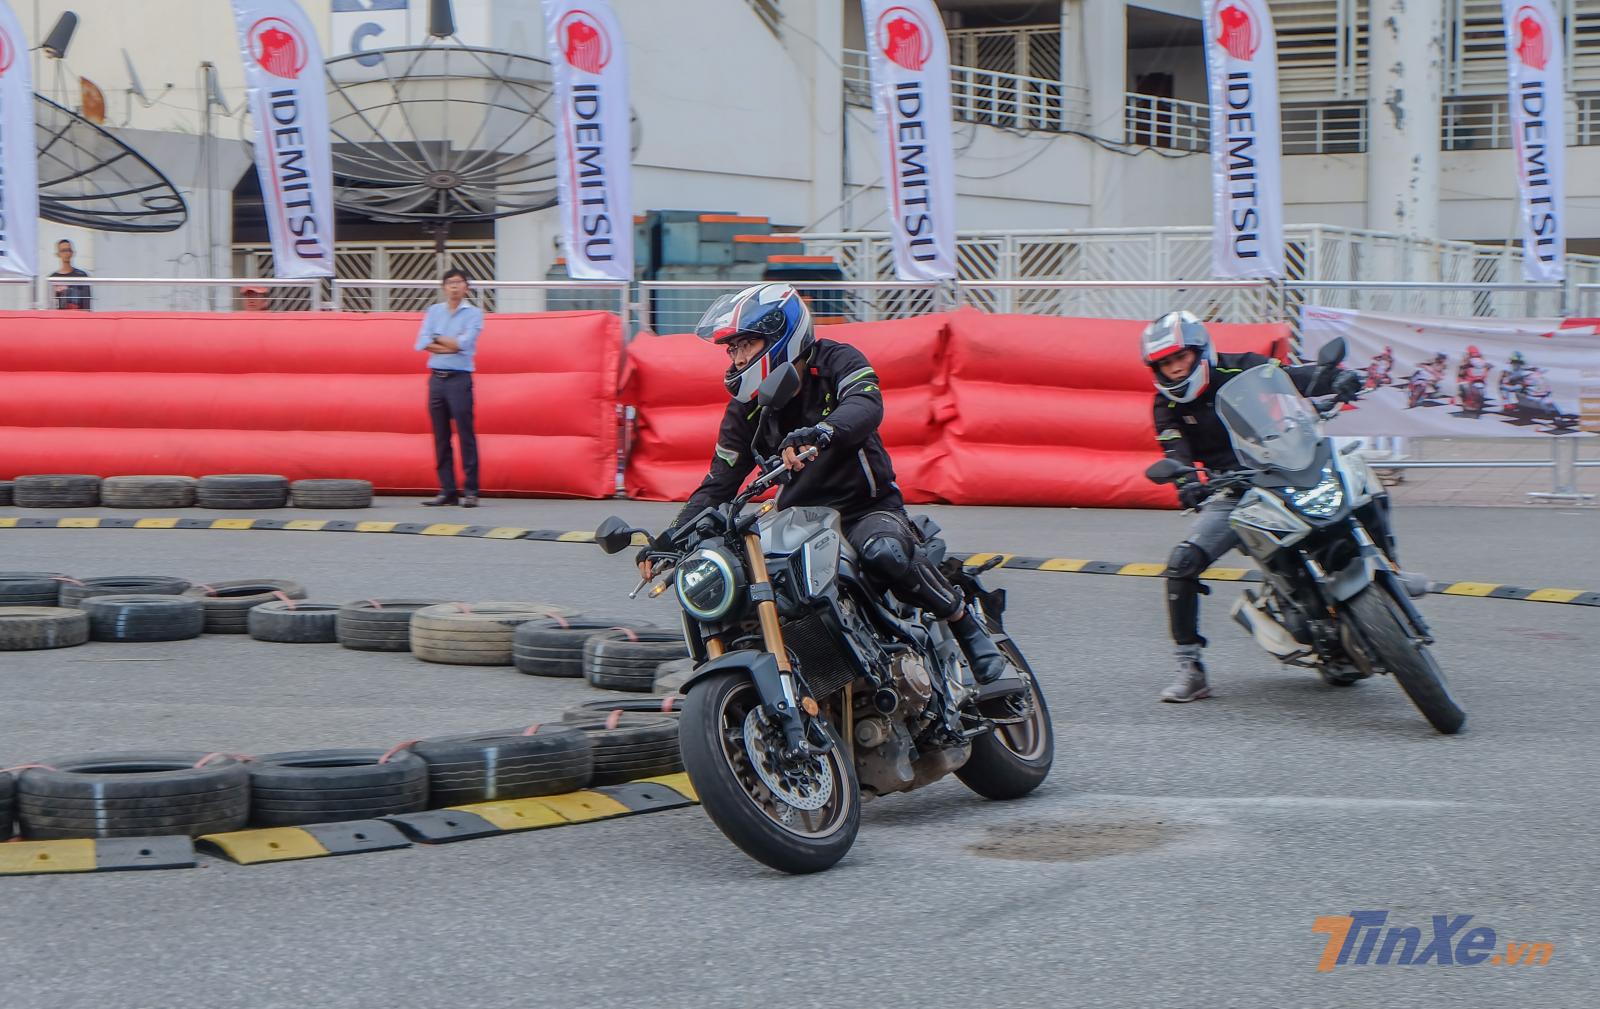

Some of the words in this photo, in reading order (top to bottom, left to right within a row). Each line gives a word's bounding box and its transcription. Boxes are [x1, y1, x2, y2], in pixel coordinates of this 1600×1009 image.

[269, 88, 324, 259] IDEMITSU
[570, 83, 615, 262] IDEMITSU
[896, 81, 936, 263] IDEMITSU
[1228, 71, 1259, 259] IDEMITSU
[1521, 80, 1556, 263] IDEMITSU
